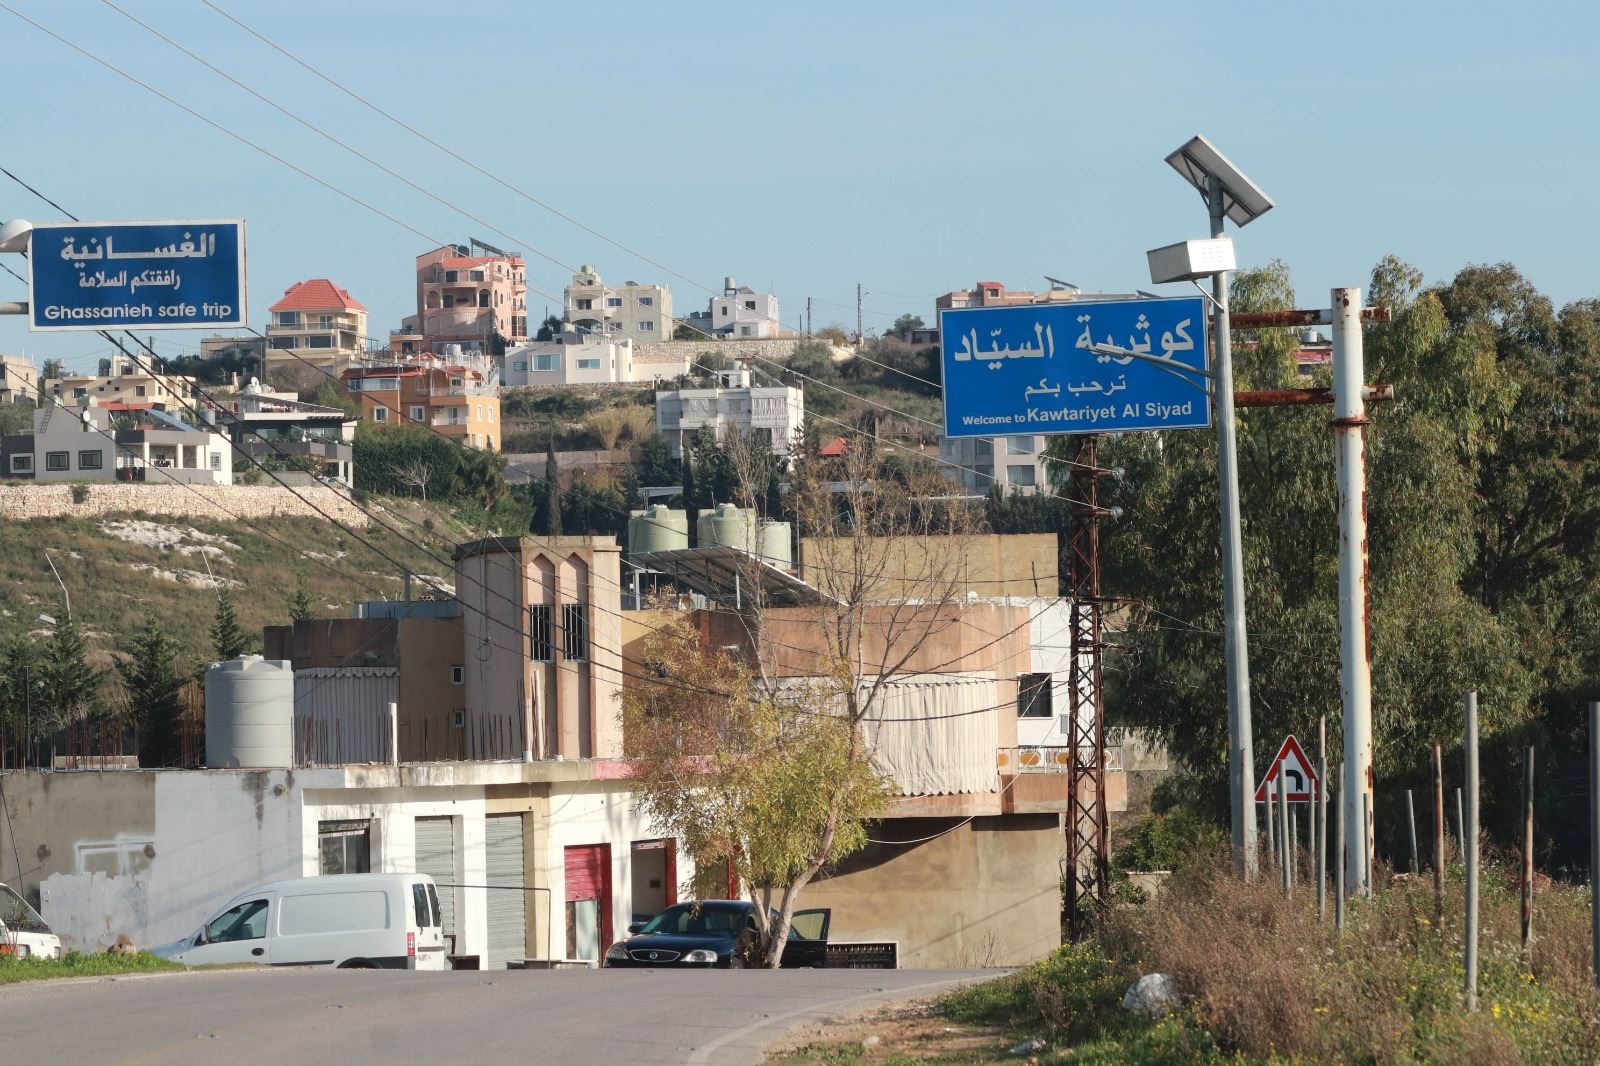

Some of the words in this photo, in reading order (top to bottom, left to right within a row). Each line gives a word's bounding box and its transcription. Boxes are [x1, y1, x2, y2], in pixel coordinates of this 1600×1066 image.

[60, 231, 216, 268] الغسانية
[79, 270, 127, 288] السلامة
[130, 269, 181, 294] رافقتكم
[44, 303, 153, 320] Ghassanieh
[158, 302, 197, 317] safe
[202, 303, 232, 319] trip
[1024, 378, 1061, 402] بكم
[1067, 374, 1126, 397] ترحب
[962, 415, 1012, 426] Welcome
[1014, 414, 1026, 423] to
[1027, 405, 1116, 423] Kawtariyet
[1122, 403, 1140, 418] Al
[1145, 401, 1192, 419] Siyad
